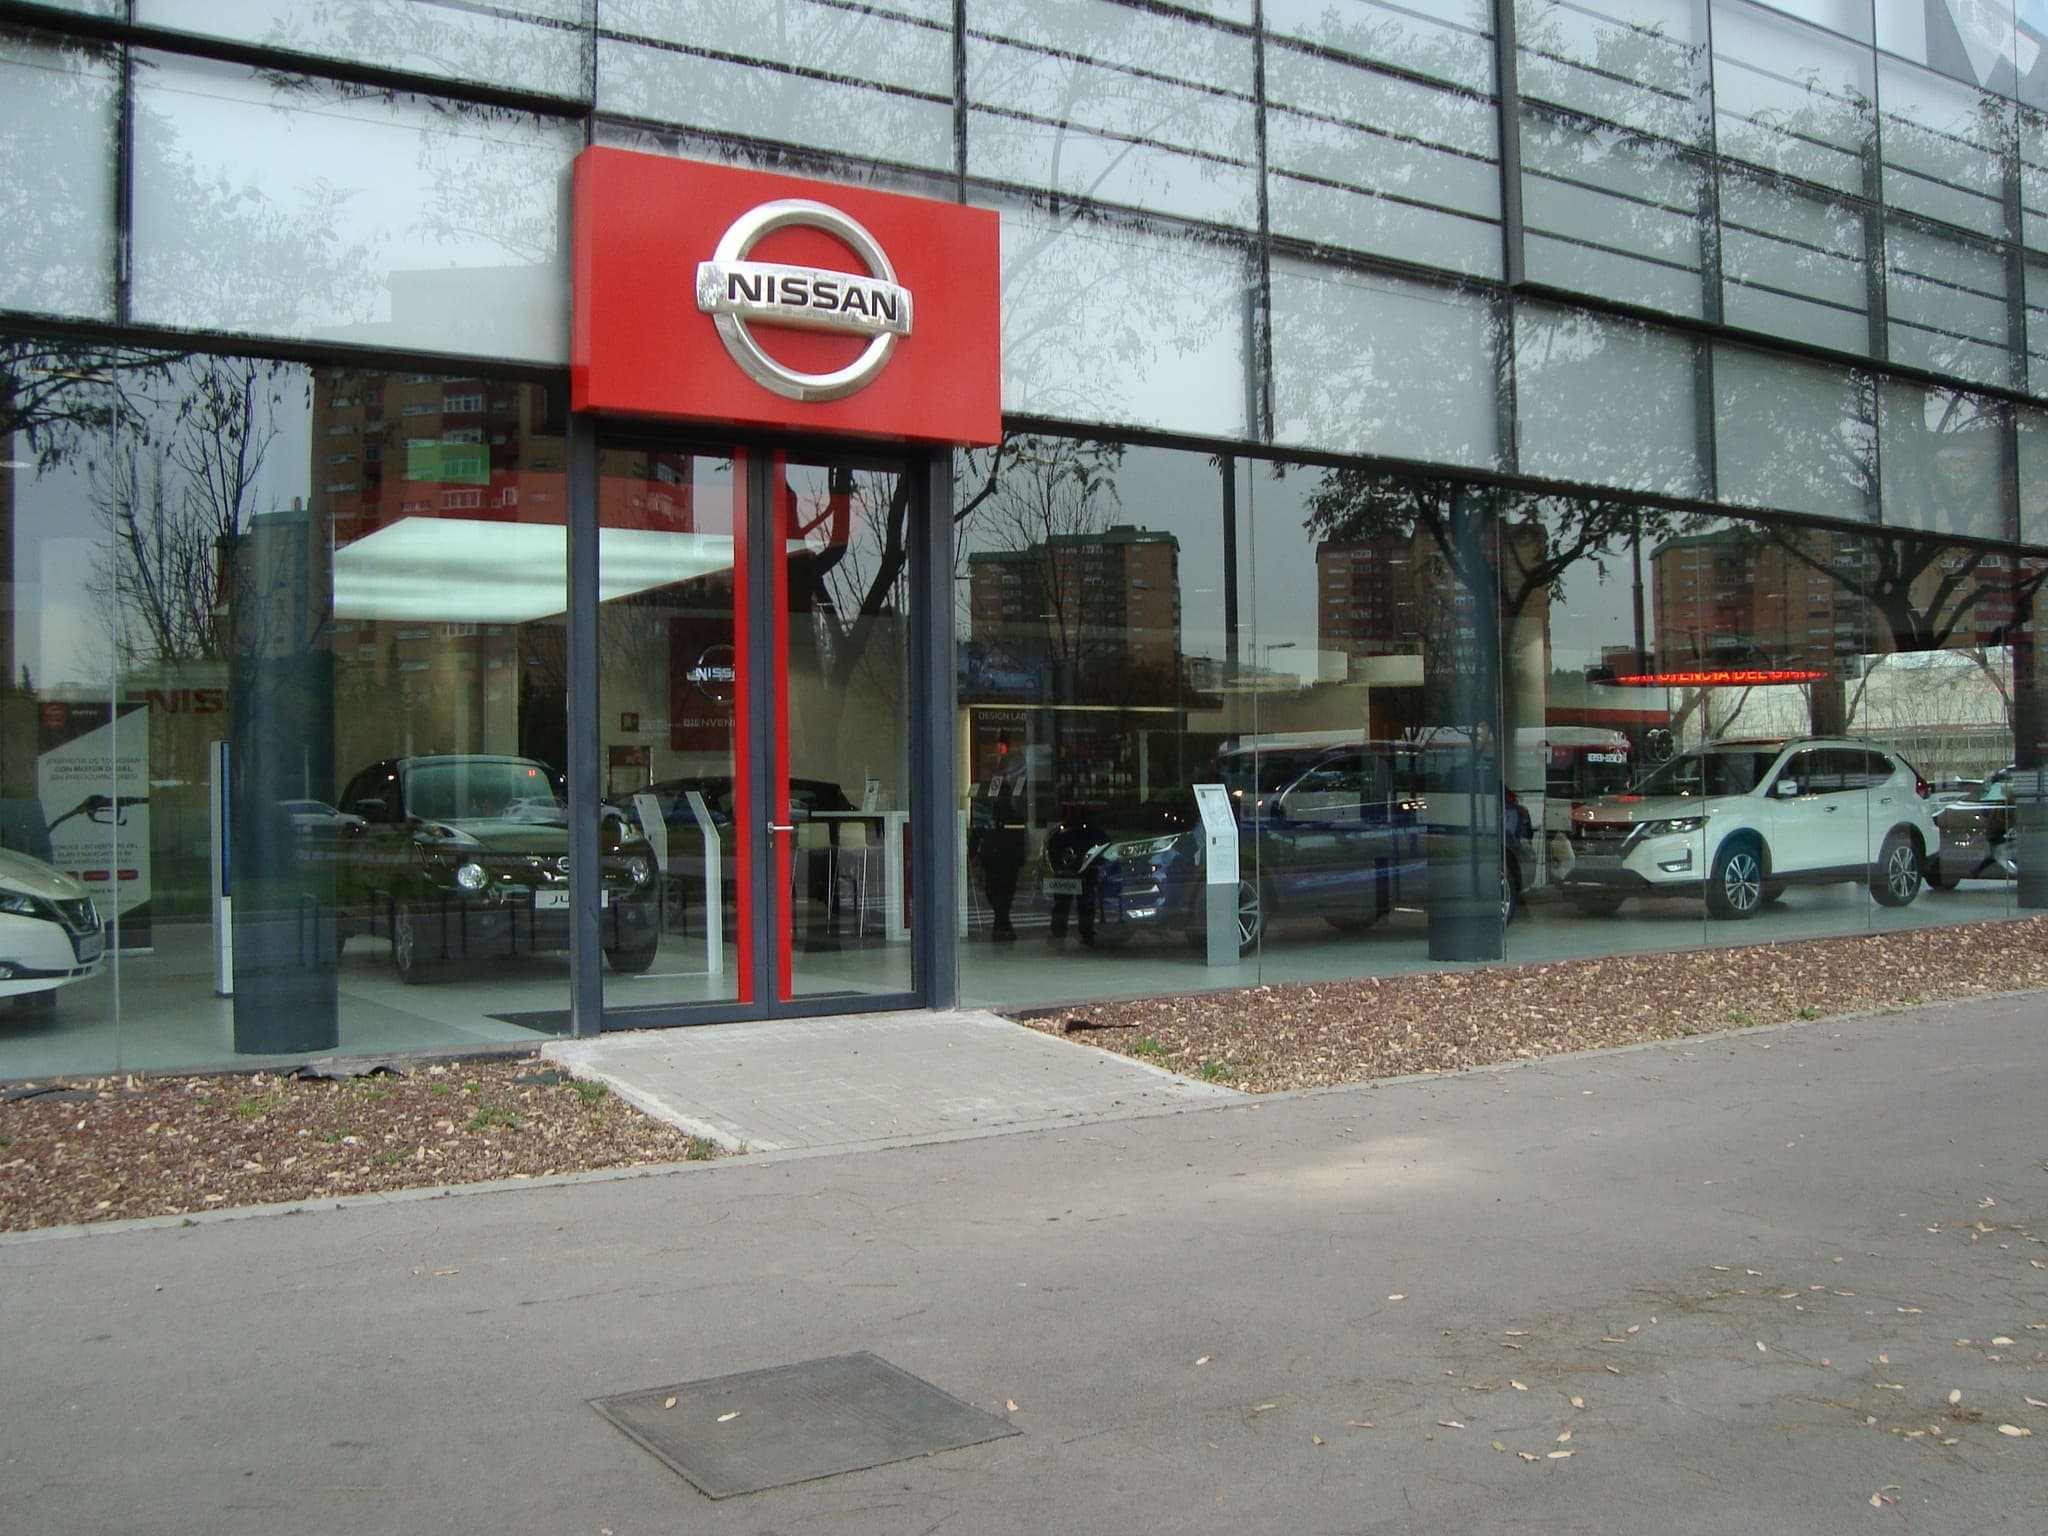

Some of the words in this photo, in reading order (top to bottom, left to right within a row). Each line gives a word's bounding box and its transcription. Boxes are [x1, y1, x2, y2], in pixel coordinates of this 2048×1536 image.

[727, 272, 898, 321] NISSAN
[696, 667, 735, 681] NISS
[148, 688, 230, 714] NIS
